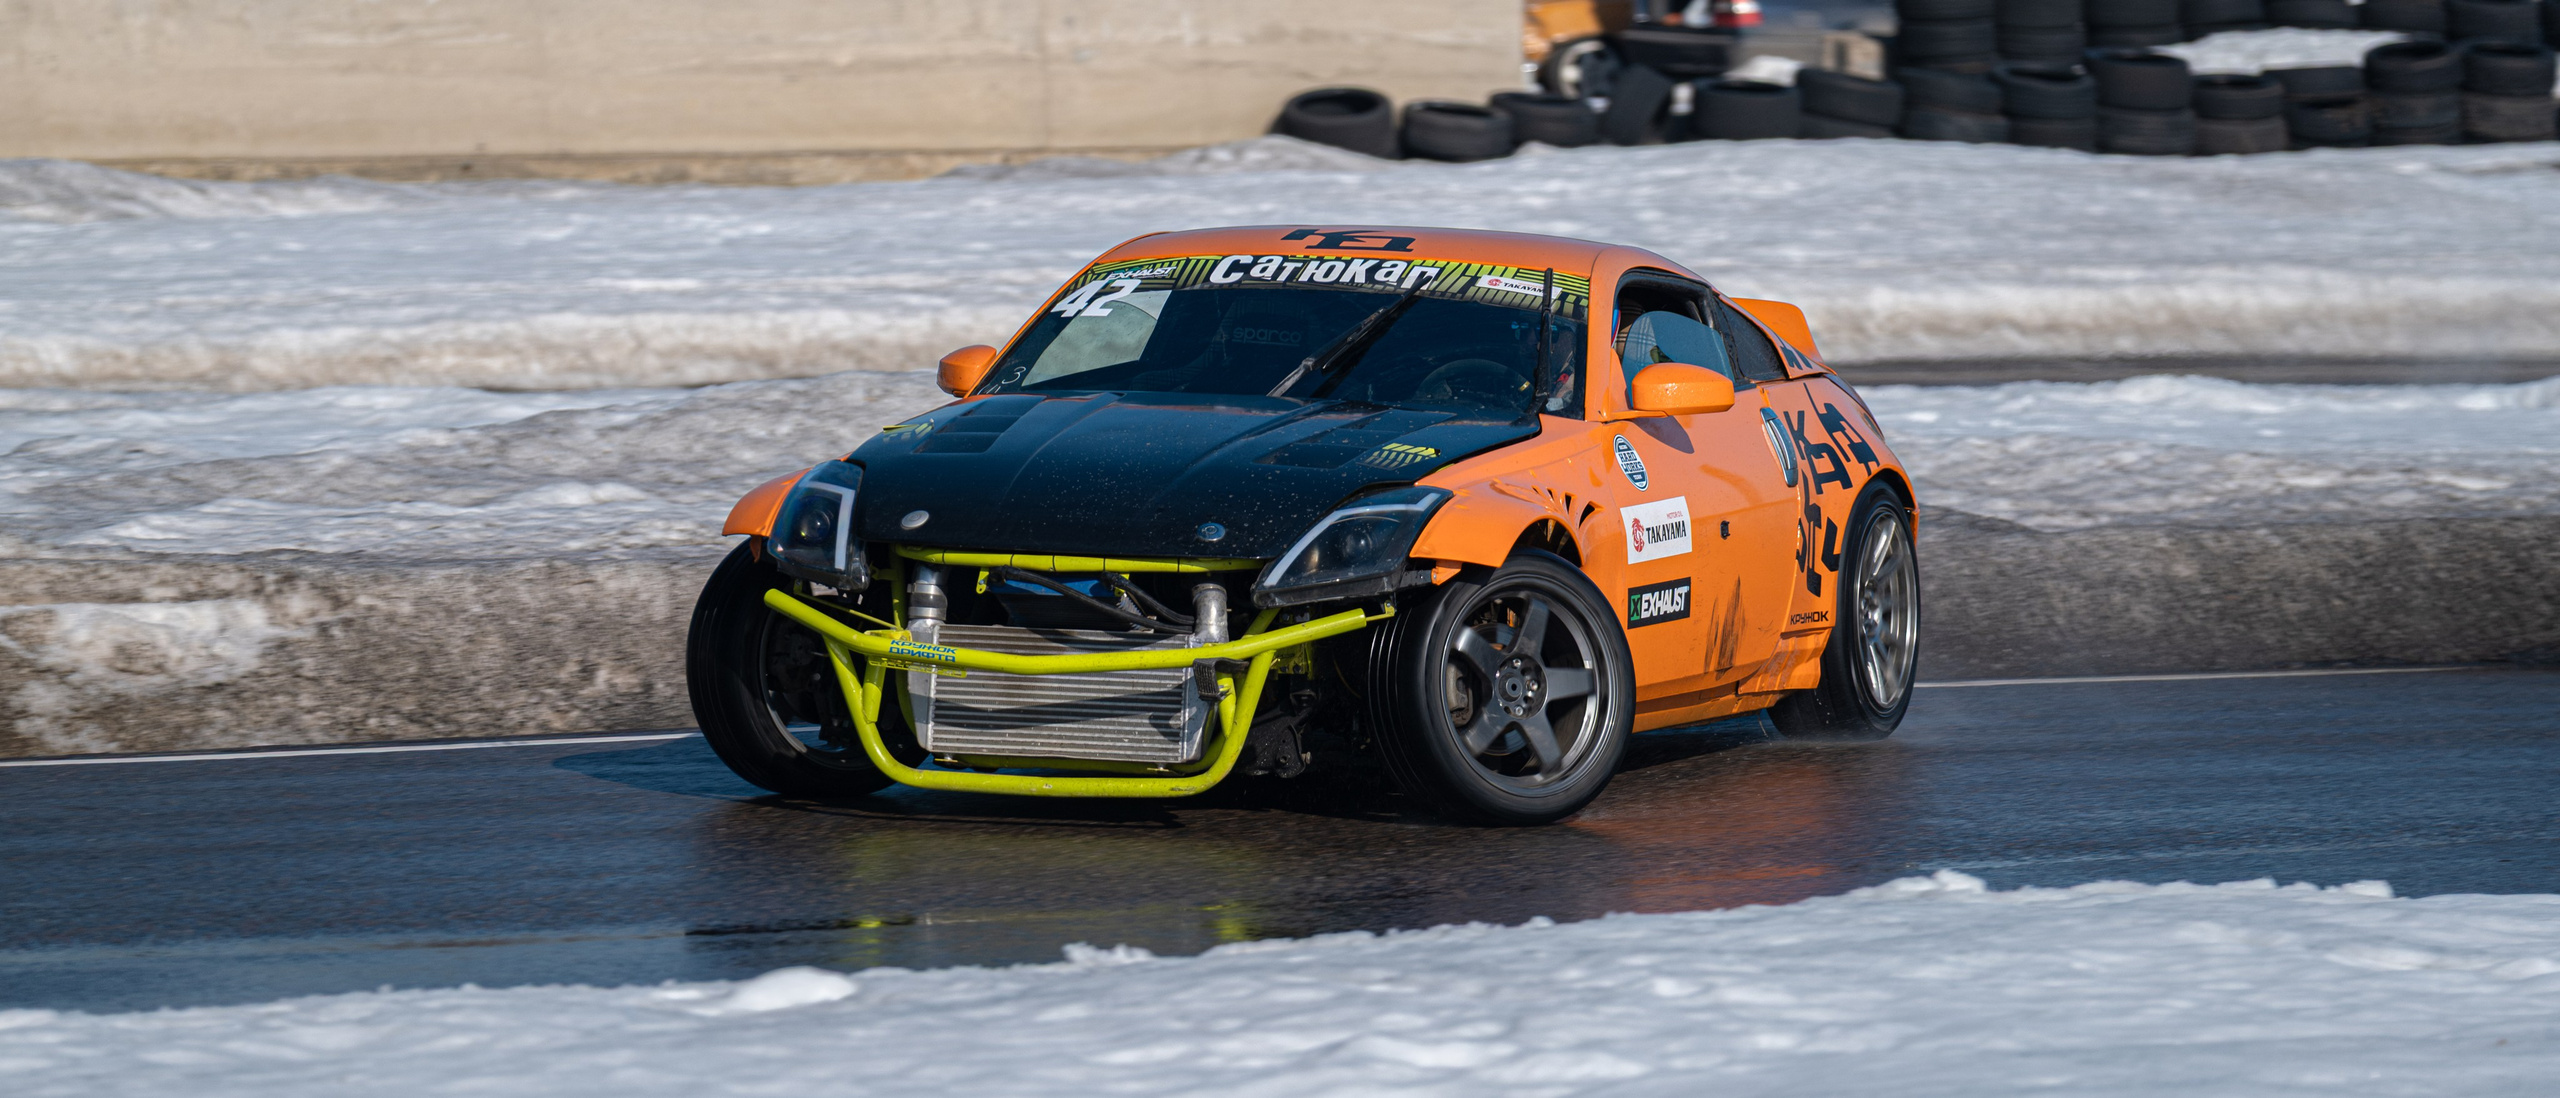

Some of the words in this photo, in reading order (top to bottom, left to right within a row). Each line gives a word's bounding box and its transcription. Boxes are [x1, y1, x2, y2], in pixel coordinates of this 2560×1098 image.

[1106, 266, 1177, 280] EXHAUST
[1503, 282, 1546, 294] TAKAYAM
[1050, 279, 1142, 318] 42
[1233, 327, 1301, 344] sparco
[1645, 520, 1687, 545] TAKAYAMA
[1790, 610, 1829, 626] КРУЖОК
[889, 647, 955, 662] ДРИФТА
[890, 640, 957, 654] КРУЖОК
